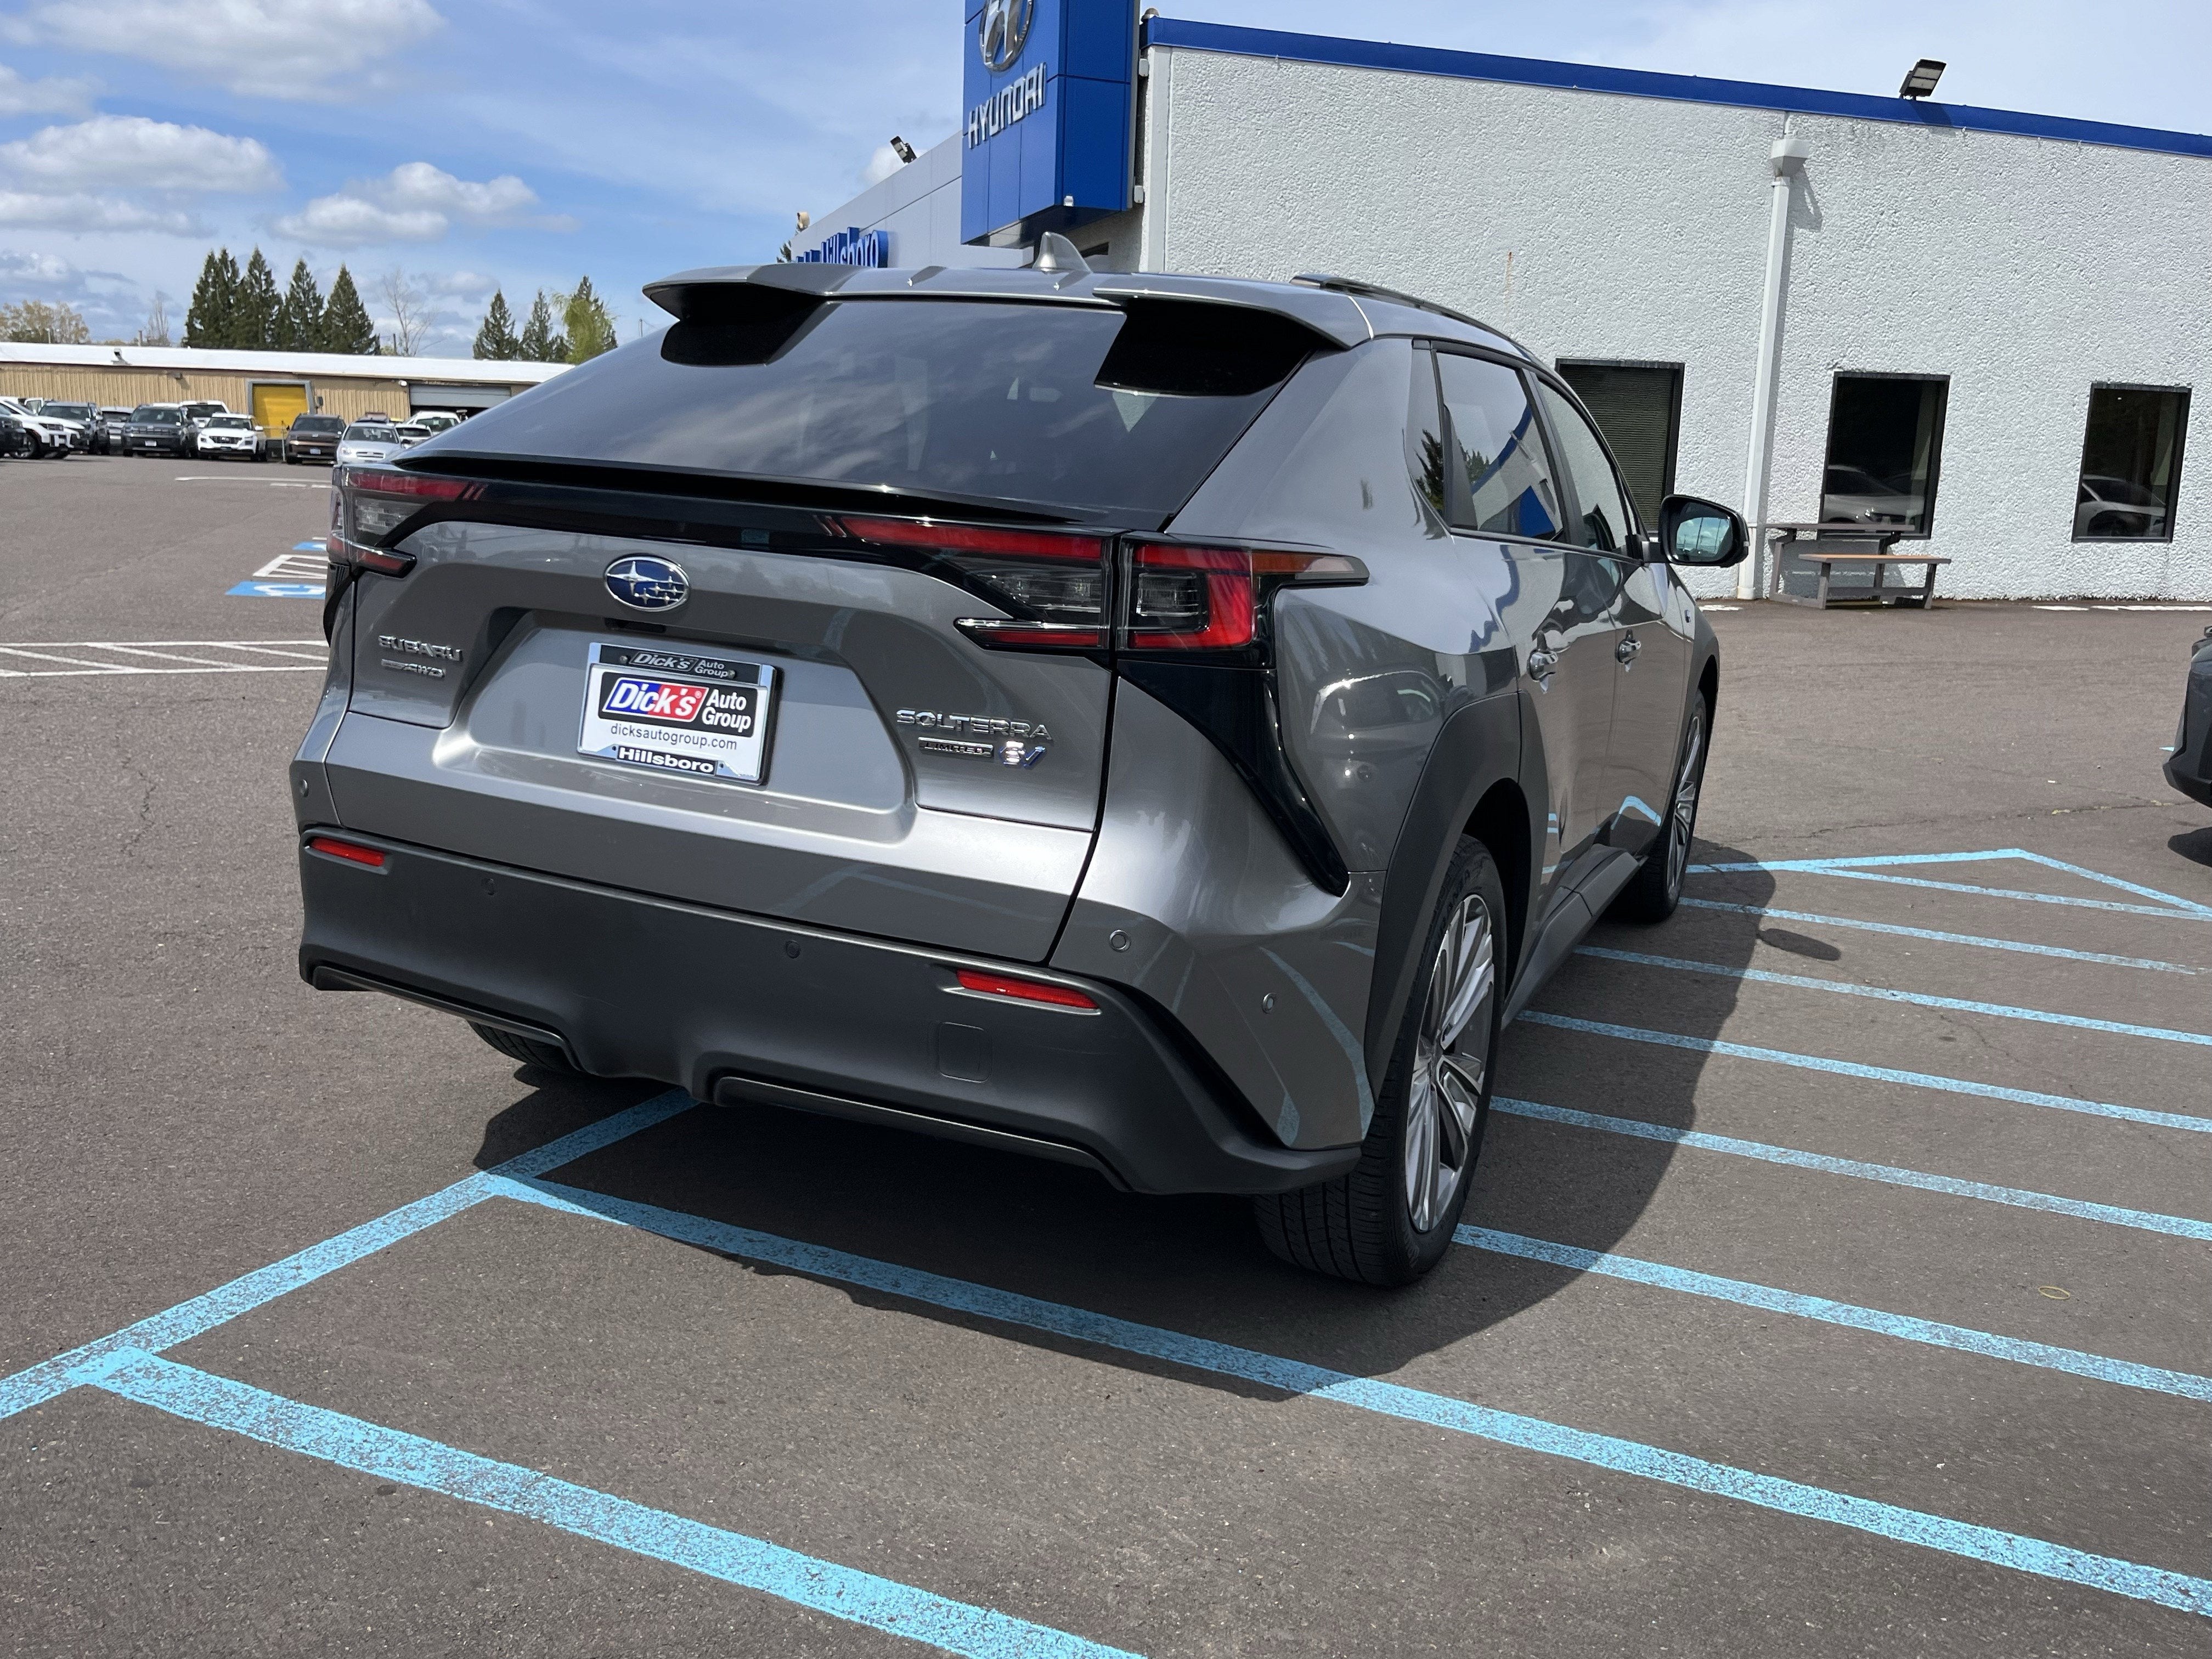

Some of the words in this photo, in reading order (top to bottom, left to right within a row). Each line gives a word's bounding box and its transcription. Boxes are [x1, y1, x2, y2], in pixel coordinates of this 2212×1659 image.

[968, 62, 1046, 149] HYUNDAI
[378, 635, 464, 662] SUBARU
[633, 652, 691, 670] Dick's
[698, 659, 725, 670] Auto
[695, 665, 729, 678] Group
[610, 682, 697, 716] Dick's
[706, 689, 747, 711] Auto
[701, 707, 752, 733] Group
[896, 708, 1052, 741] SOLTERRA
[611, 723, 737, 751] dicksautogroup.com
[924, 741, 985, 755] LIMITED
[618, 747, 714, 773] Hillsboro
